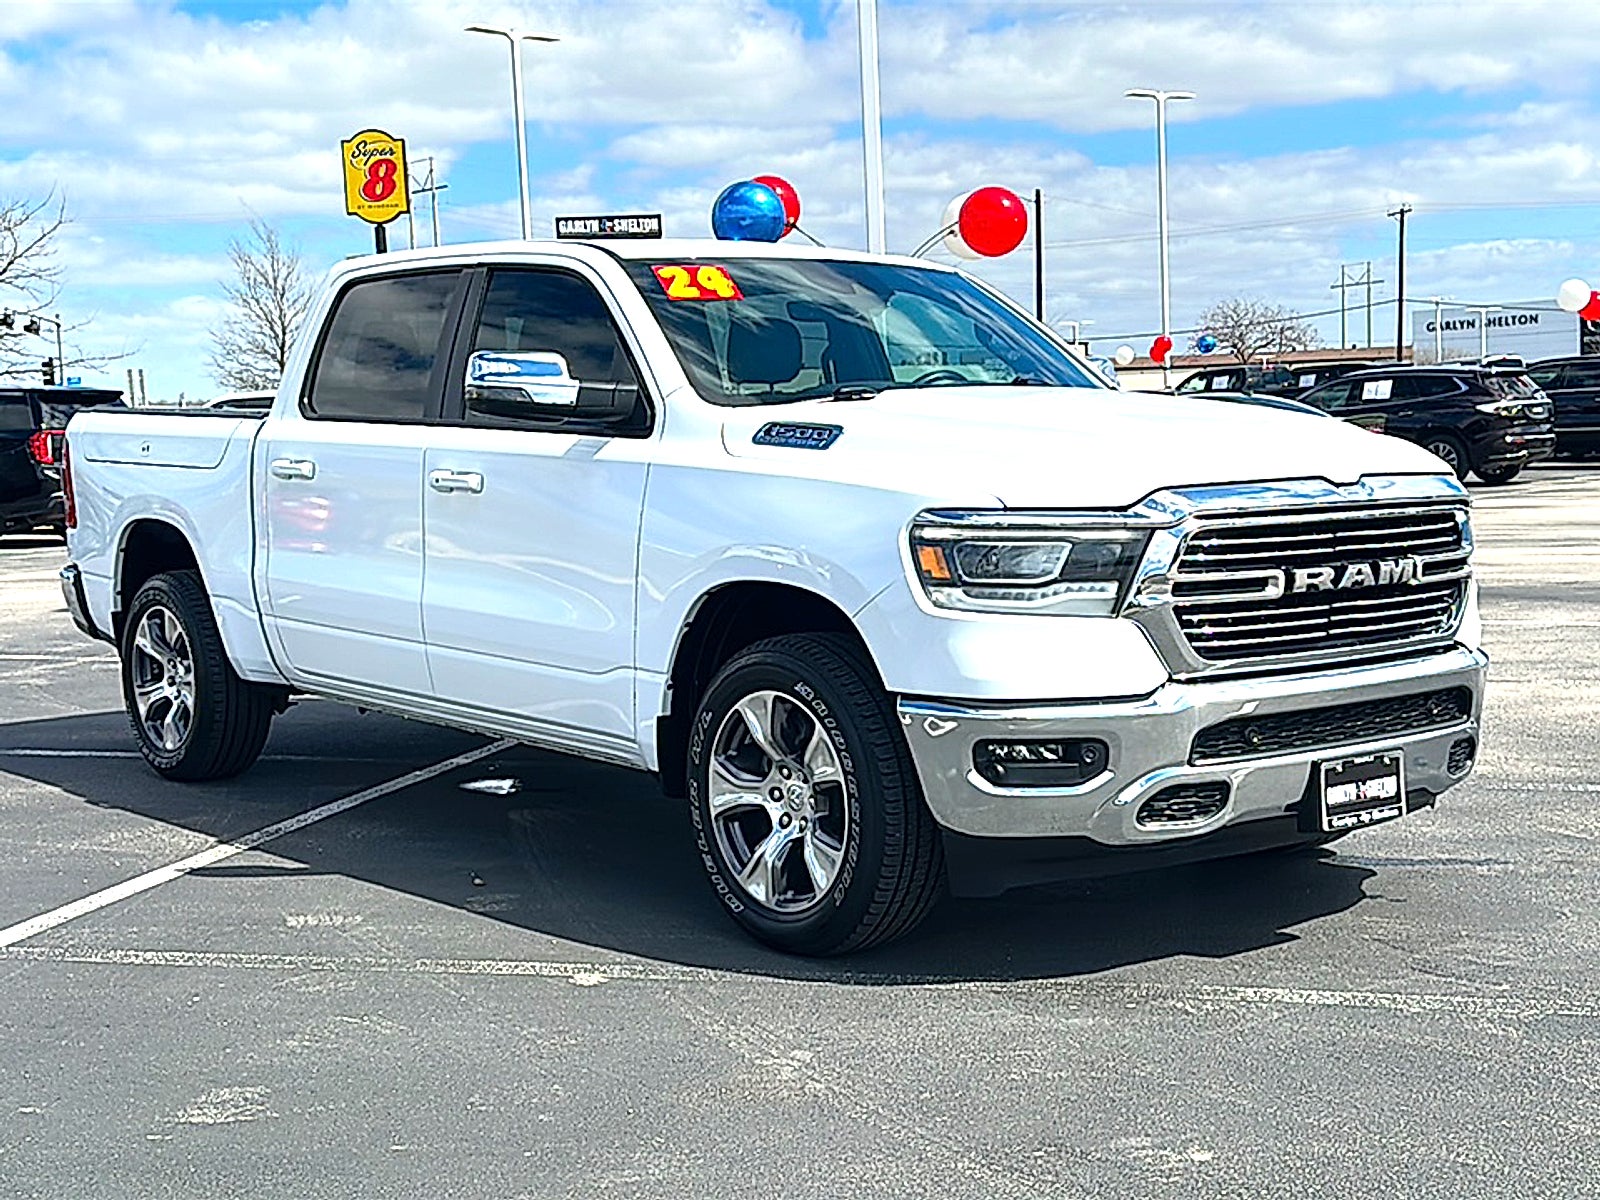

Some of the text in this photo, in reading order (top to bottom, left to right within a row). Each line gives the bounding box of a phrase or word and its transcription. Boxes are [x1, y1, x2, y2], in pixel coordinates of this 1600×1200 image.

[351, 140, 396, 166] Super
[360, 158, 397, 202] 8
[559, 218, 659, 233] GARLYN SHELTON
[1484, 314, 1538, 327] HELTON
[1291, 558, 1413, 594] RAM
